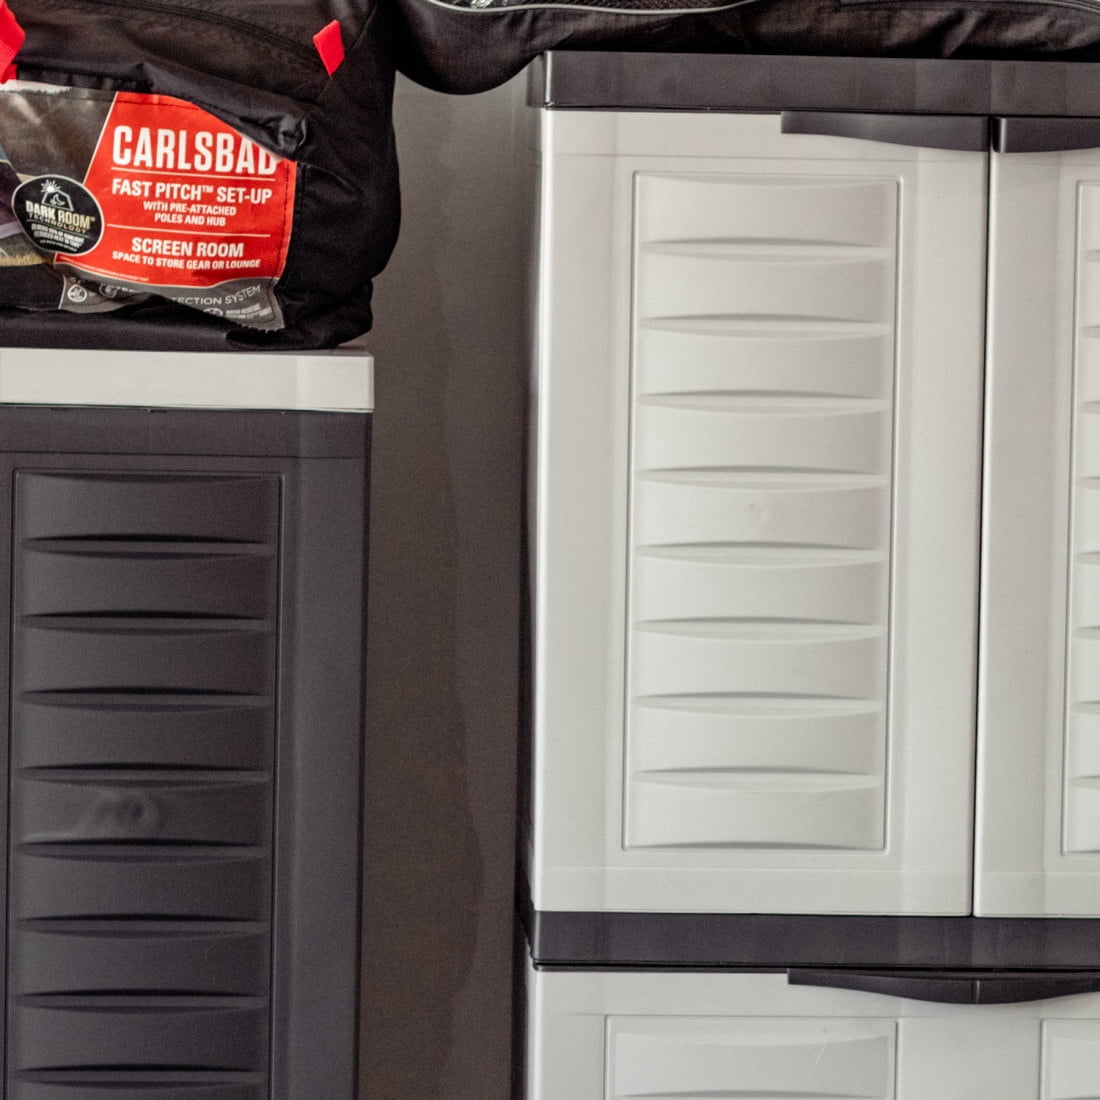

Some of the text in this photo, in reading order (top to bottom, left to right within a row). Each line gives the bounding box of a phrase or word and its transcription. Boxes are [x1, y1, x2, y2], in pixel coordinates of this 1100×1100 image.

[112, 125, 277, 175] CARLSBAD
[112, 178, 152, 197] FAST
[216, 186, 272, 204] SET-UP
[25, 200, 56, 220] DARK
[143, 201, 237, 217] WITH PRE-ATTACHED
[28, 212, 88, 234] TECHNOLOGY
[154, 213, 226, 226] POLES AND HUB
[131, 237, 244, 258] SCREEN ROOM
[112, 251, 261, 270] SPACE TO STORE GEAR OR LOUNGE
[224, 284, 261, 304] SYSTEM
